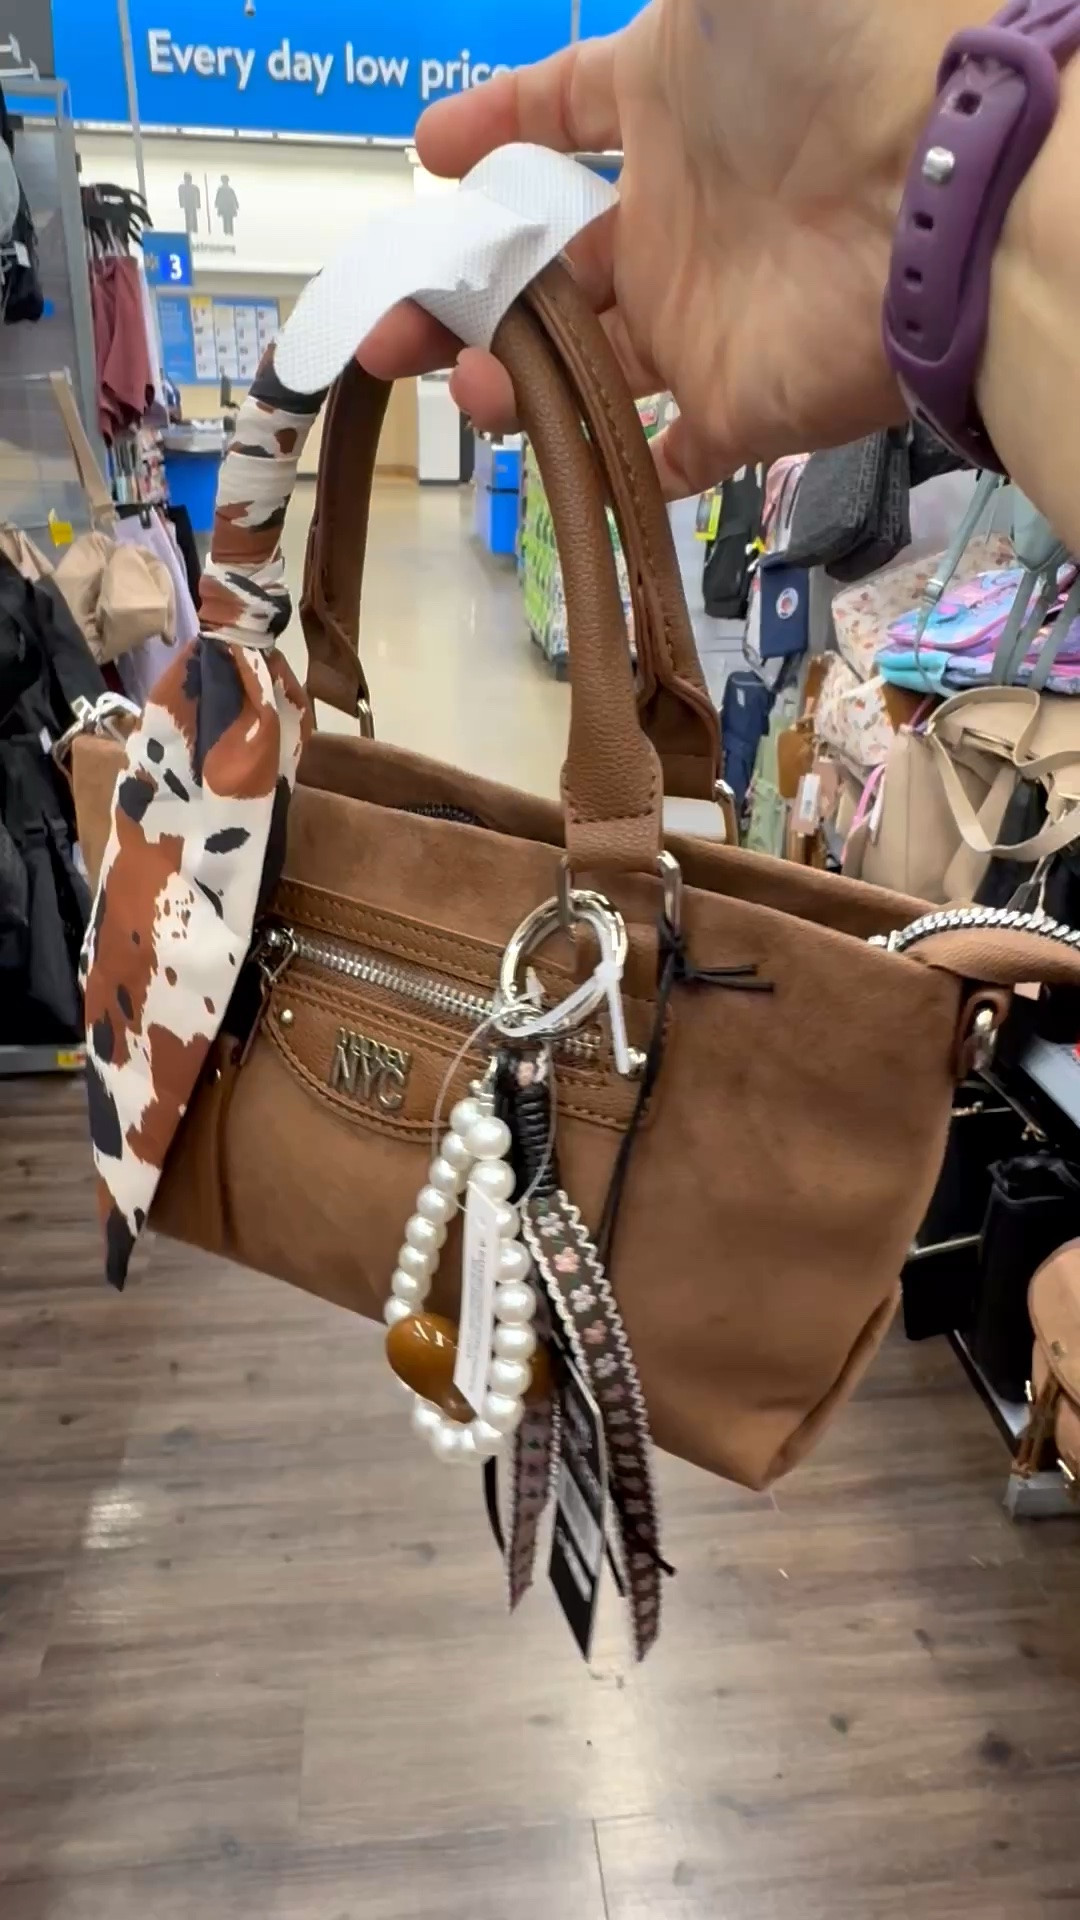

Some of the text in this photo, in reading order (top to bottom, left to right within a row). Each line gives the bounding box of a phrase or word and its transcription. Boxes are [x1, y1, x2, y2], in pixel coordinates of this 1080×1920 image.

[148, 29, 525, 100] Every day low pric
[169, 253, 183, 280] 3
[332, 1044, 405, 1110] NYC
